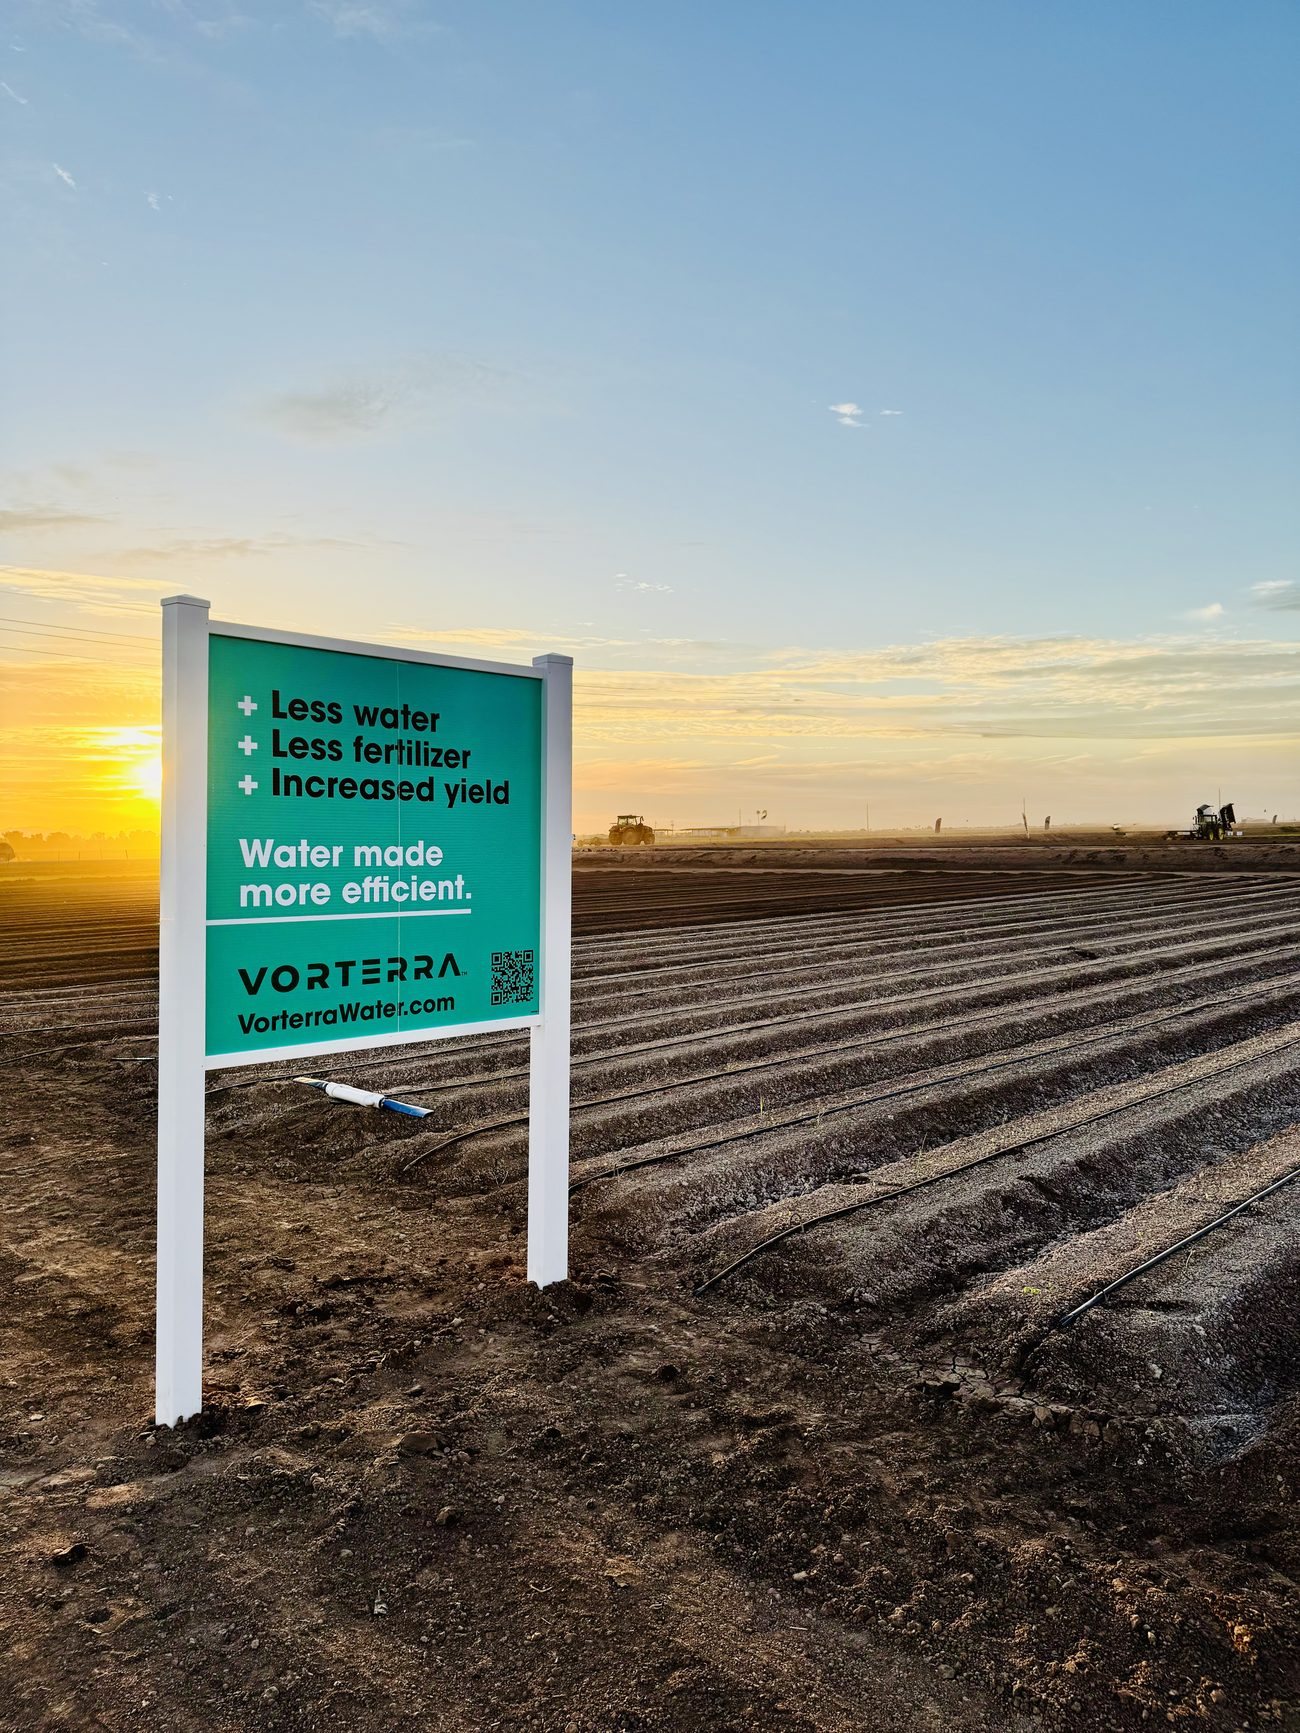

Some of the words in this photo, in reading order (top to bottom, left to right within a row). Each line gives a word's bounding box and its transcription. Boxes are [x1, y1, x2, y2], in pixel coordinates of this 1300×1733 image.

[271, 689, 343, 725] Less
[353, 703, 441, 732] water
[272, 729, 343, 762] Less
[353, 735, 471, 769] fertilizer
[272, 767, 435, 802] Increased
[443, 778, 510, 808] yield
[239, 838, 344, 868] Water
[354, 840, 443, 867] made
[240, 882, 331, 907] more
[342, 874, 472, 904] efficient.
[238, 953, 461, 996] VORTERRA
[238, 996, 455, 1035] VorterraWater.com
